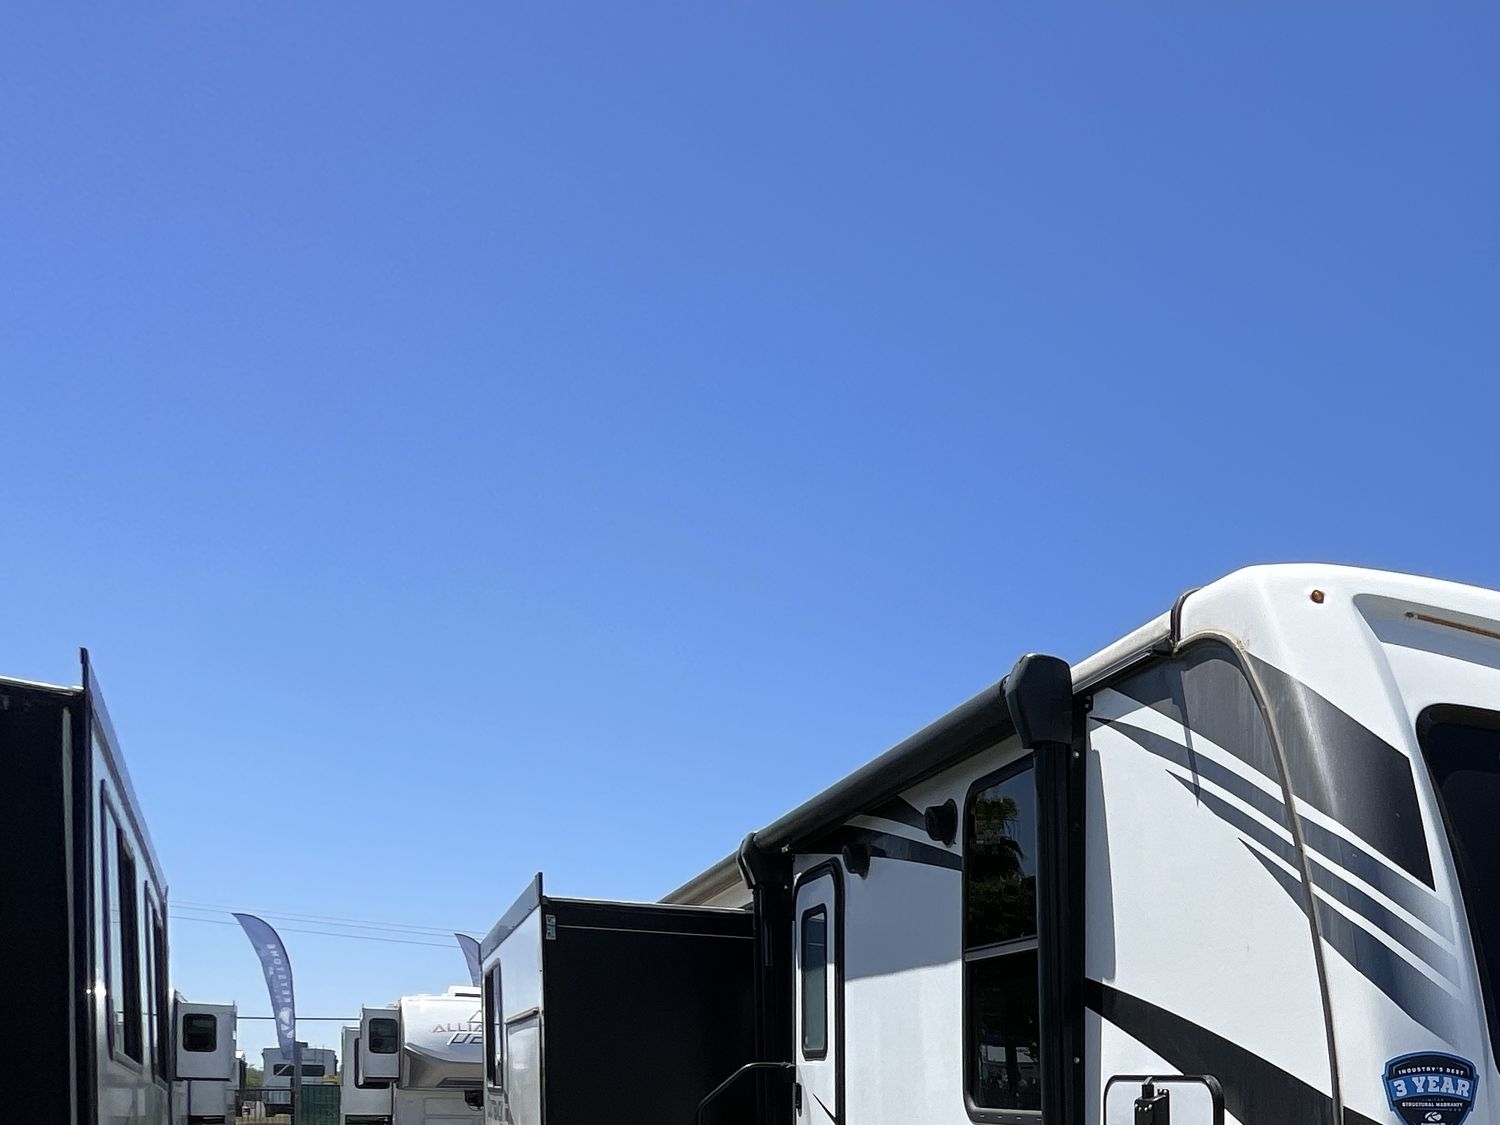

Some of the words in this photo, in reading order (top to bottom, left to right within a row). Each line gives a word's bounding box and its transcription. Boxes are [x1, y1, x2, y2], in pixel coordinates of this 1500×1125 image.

[1398, 1066, 1443, 1075] INDUSTRY'S
[1446, 1067, 1464, 1076] BEST
[1393, 1079, 1408, 1097] 3
[1411, 1076, 1470, 1098] YEAR
